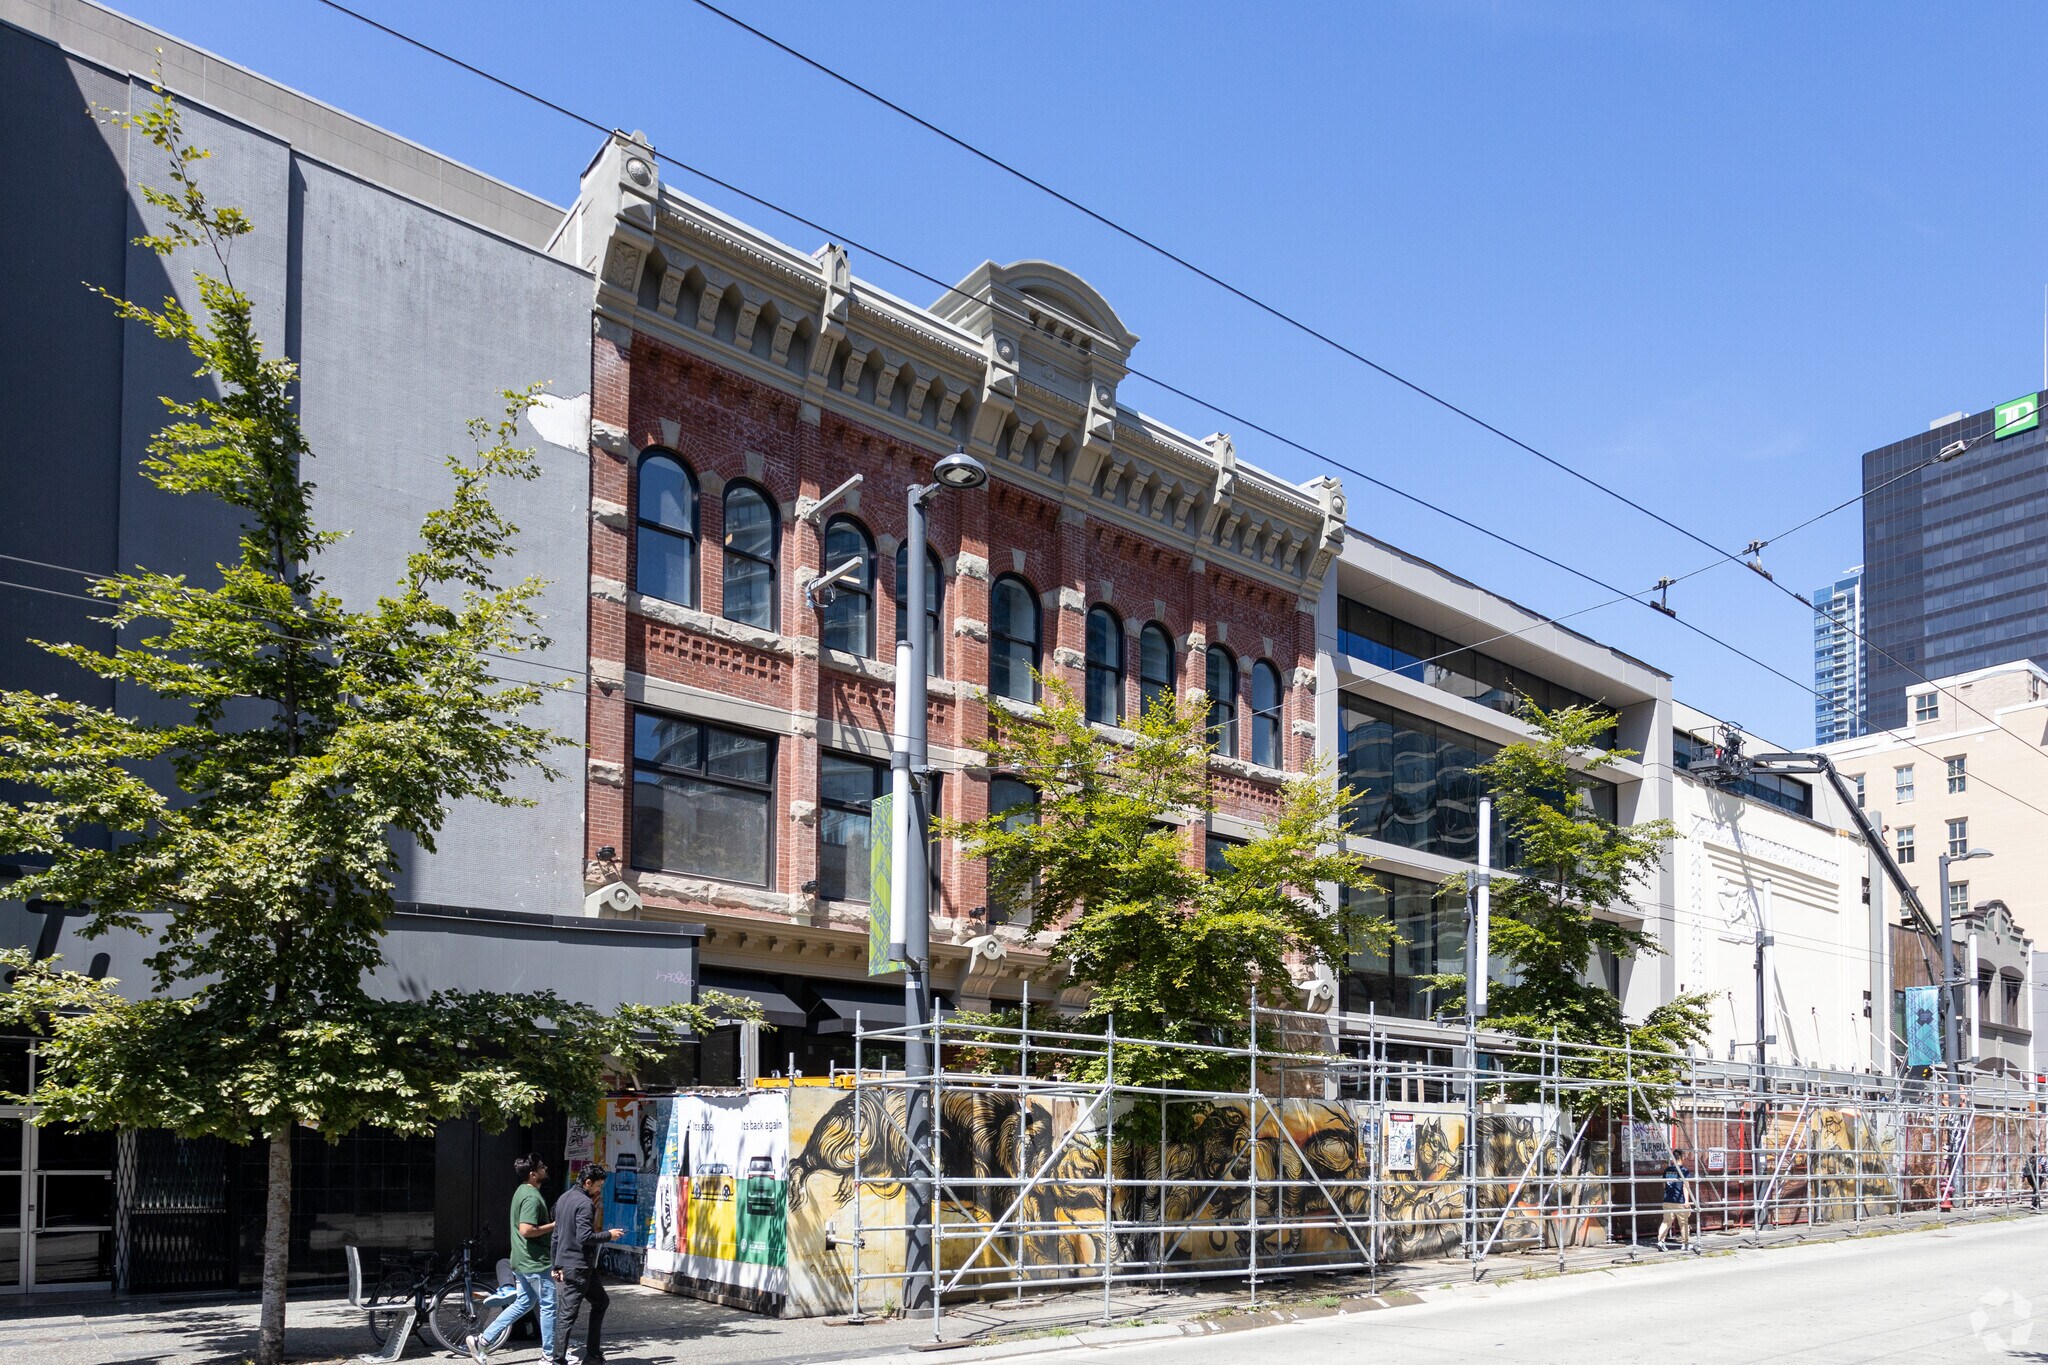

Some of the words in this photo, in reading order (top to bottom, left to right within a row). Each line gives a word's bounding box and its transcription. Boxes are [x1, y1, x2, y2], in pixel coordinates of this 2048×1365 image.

[1998, 401, 2034, 429] TD
[619, 1120, 631, 1131] back
[750, 1120, 763, 1130] back
[765, 1118, 782, 1132] again
